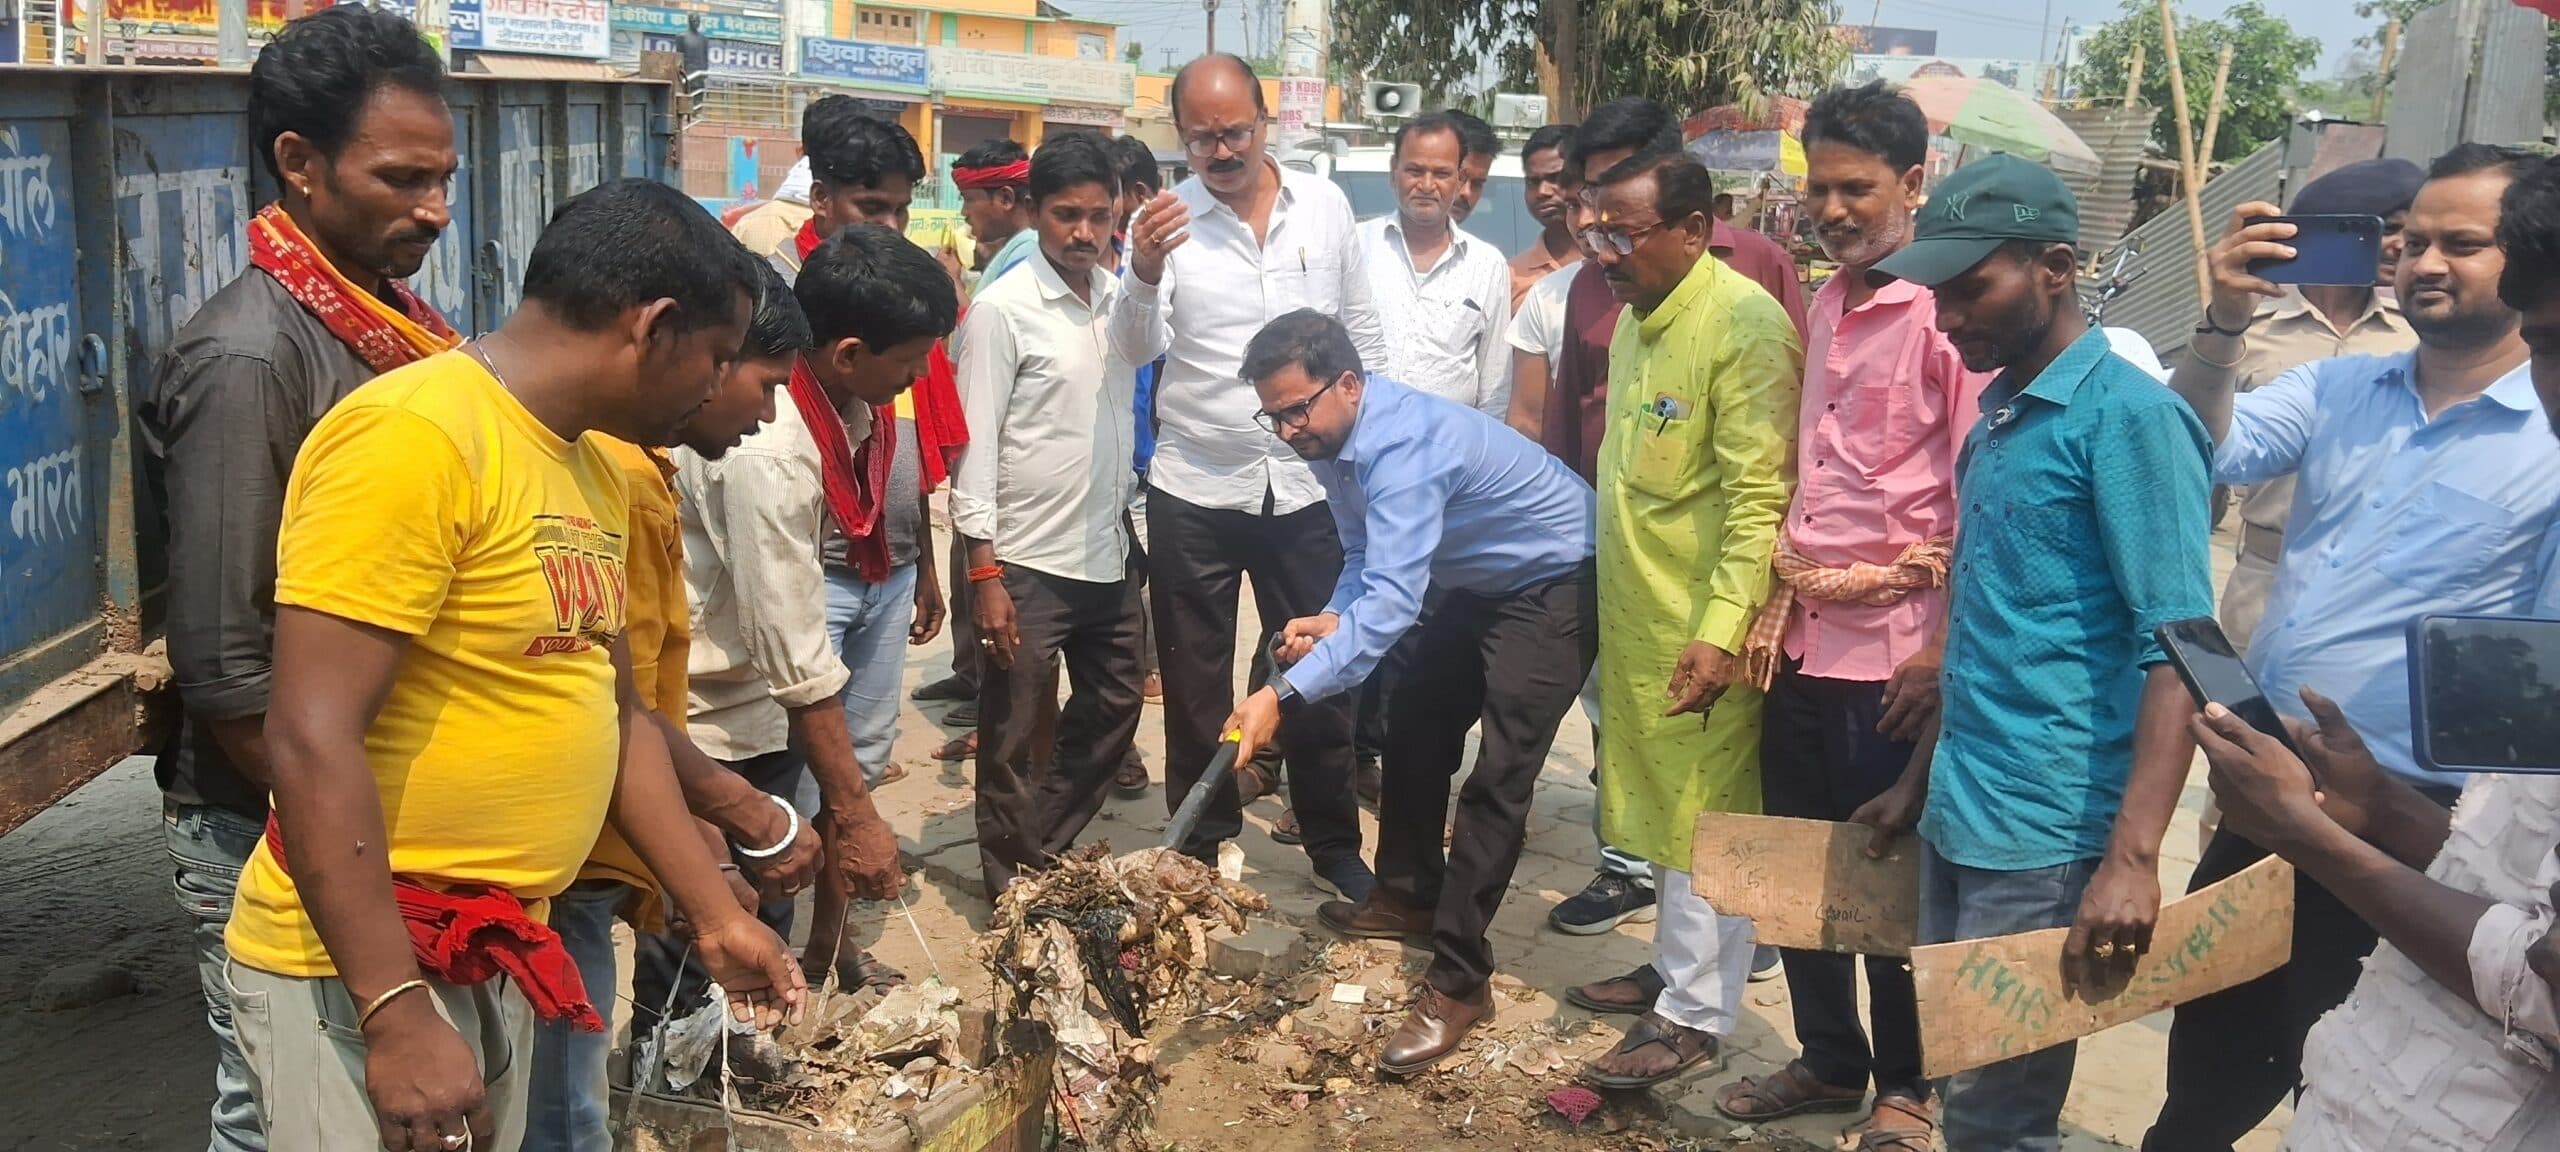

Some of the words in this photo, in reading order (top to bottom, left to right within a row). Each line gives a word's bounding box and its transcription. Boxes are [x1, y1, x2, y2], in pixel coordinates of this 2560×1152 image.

[707, 46, 780, 70] OFFICE
[807, 38, 865, 64] शिवा
[868, 45, 925, 74] सैलून
[8, 444, 83, 547] भारत
